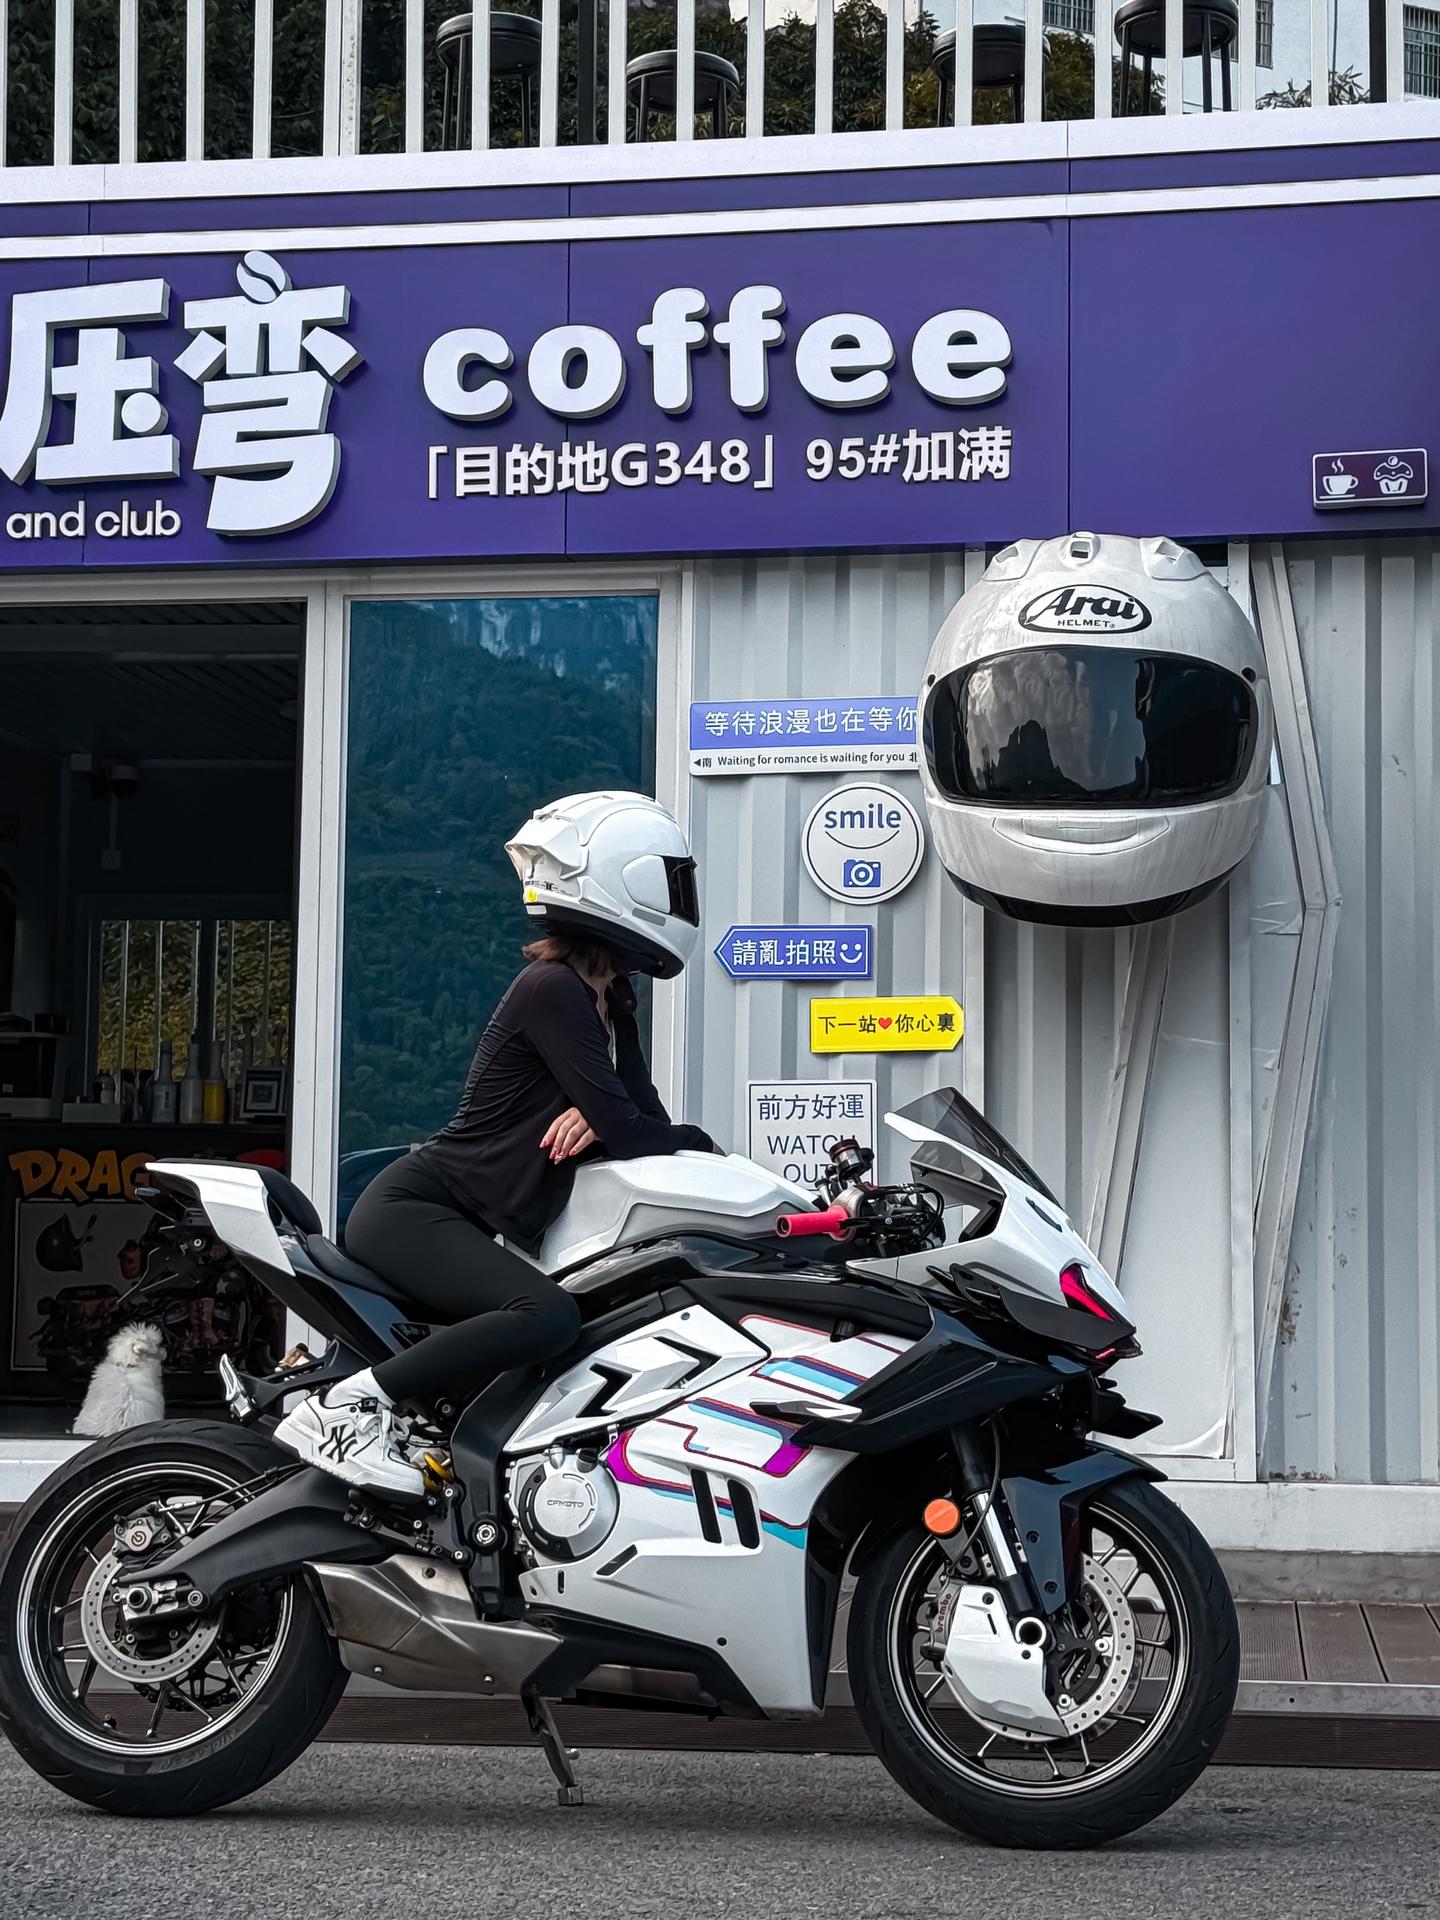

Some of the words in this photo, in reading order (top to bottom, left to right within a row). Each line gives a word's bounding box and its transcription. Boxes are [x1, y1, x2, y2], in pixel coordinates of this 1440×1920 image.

[423, 285, 1013, 422] coffee
[0, 250, 364, 537] 压弯
[427, 434, 774, 499] 「目的地G348」
[805, 425, 1012, 484] 95#加满
[6, 500, 86, 539] and
[95, 500, 182, 538] club
[1026, 588, 1139, 623] Arai
[1058, 619, 1111, 629] HELMET
[704, 706, 918, 736] 等待浪漫也在等你
[717, 756, 756, 768] Waiting
[757, 754, 772, 765] for
[774, 755, 818, 764] romance
[820, 753, 828, 763] is
[830, 752, 868, 764] waiting
[870, 752, 884, 762] for
[886, 754, 905, 763] you
[824, 803, 902, 829] smile
[732, 939, 836, 966] 請亂拍照
[757, 1093, 865, 1121] 前方好運
[767, 1135, 856, 1156] WATC
[318, 1424, 358, 1464] NY
[934, 1593, 952, 1633] brembo
